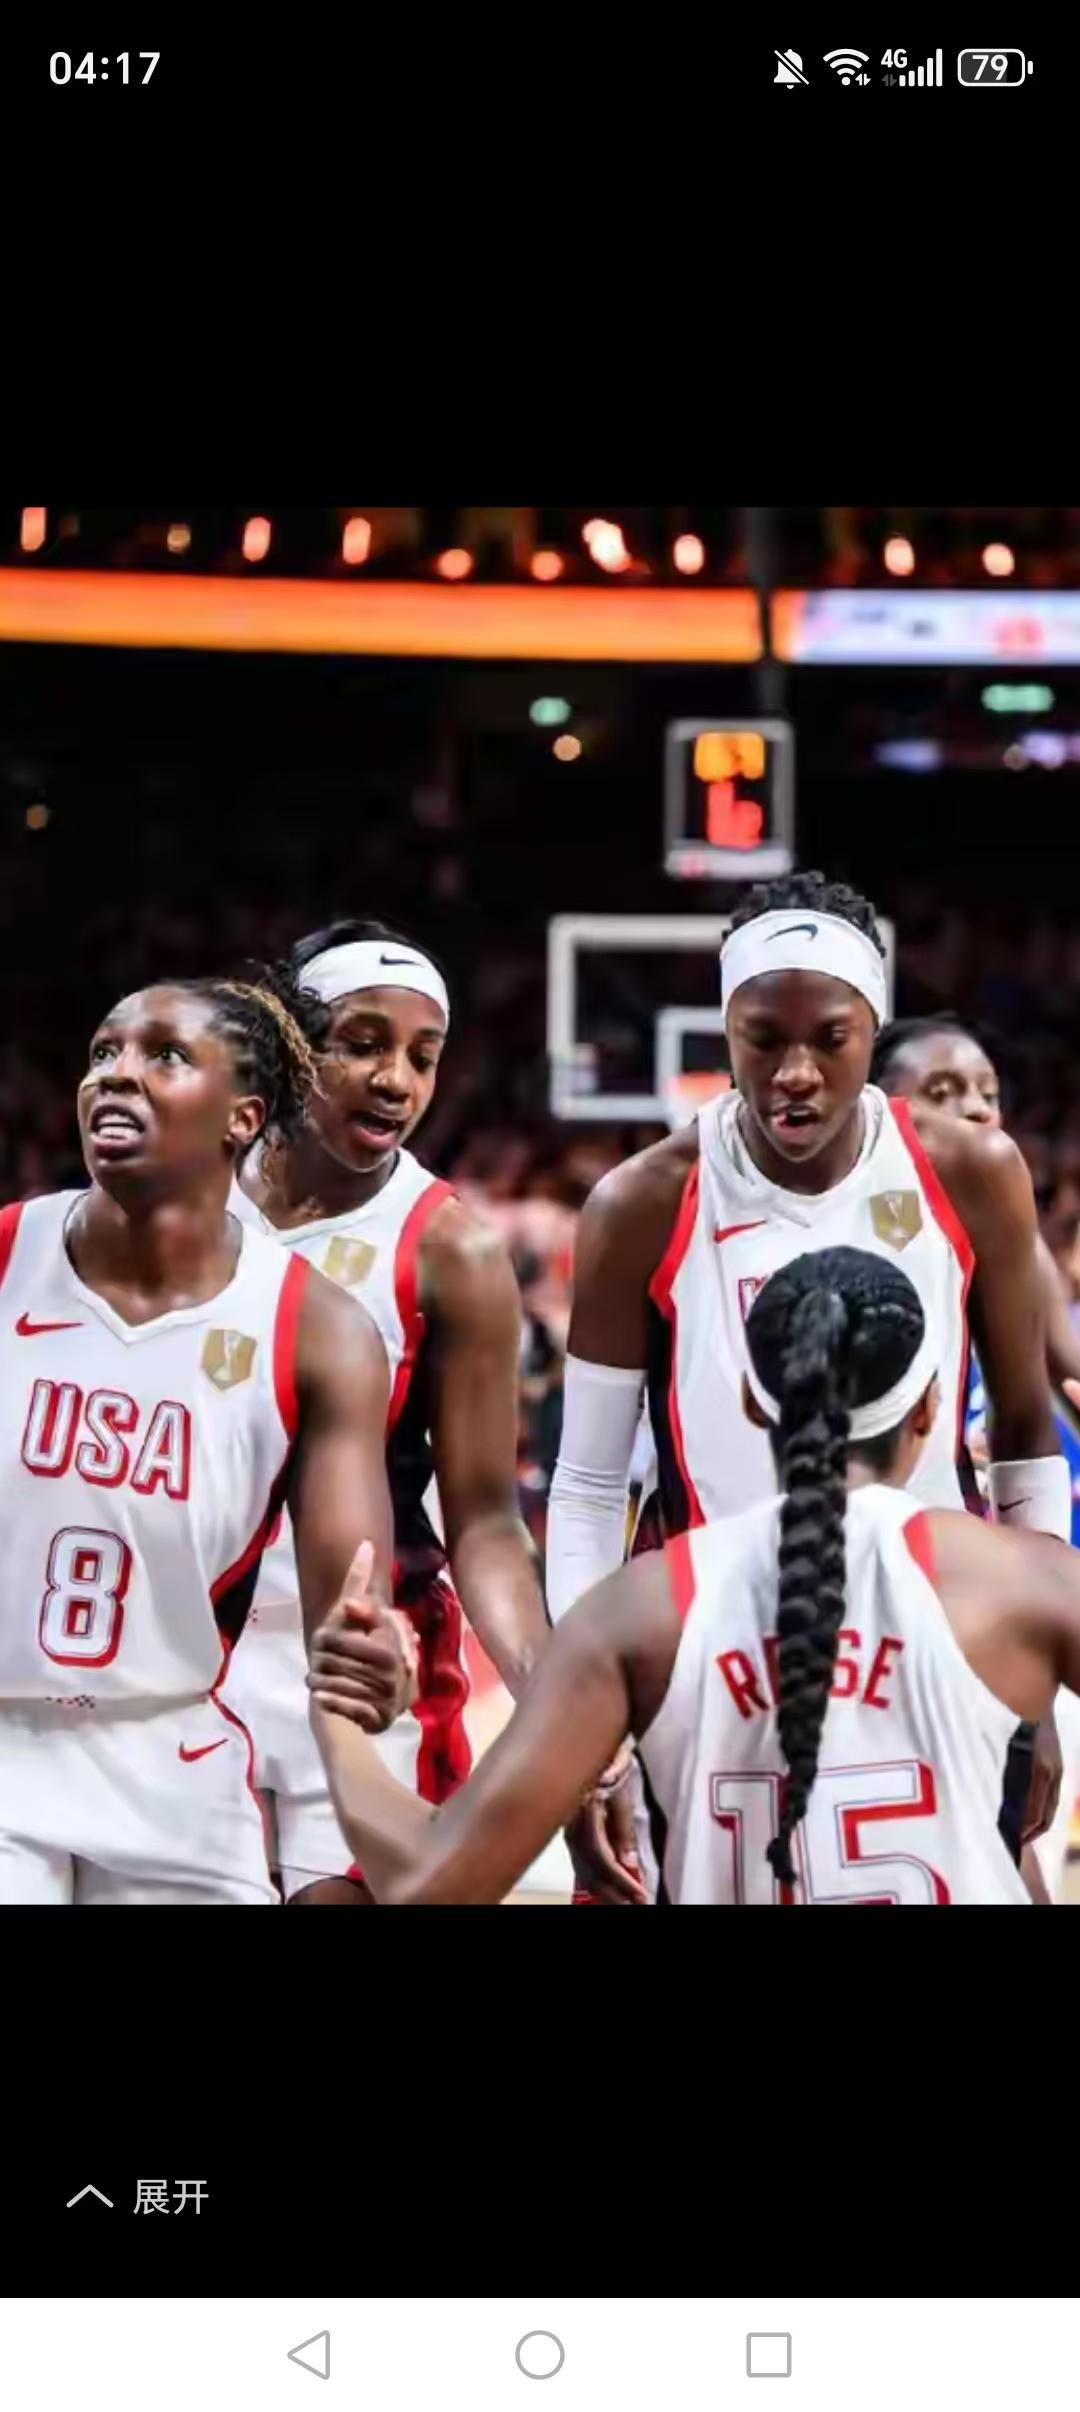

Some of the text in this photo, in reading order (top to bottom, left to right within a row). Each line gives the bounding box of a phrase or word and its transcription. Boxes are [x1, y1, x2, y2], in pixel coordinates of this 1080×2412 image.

[21, 1379, 191, 1500] USA
[39, 1526, 132, 1668] 8
[711, 1759, 951, 1904] 15
